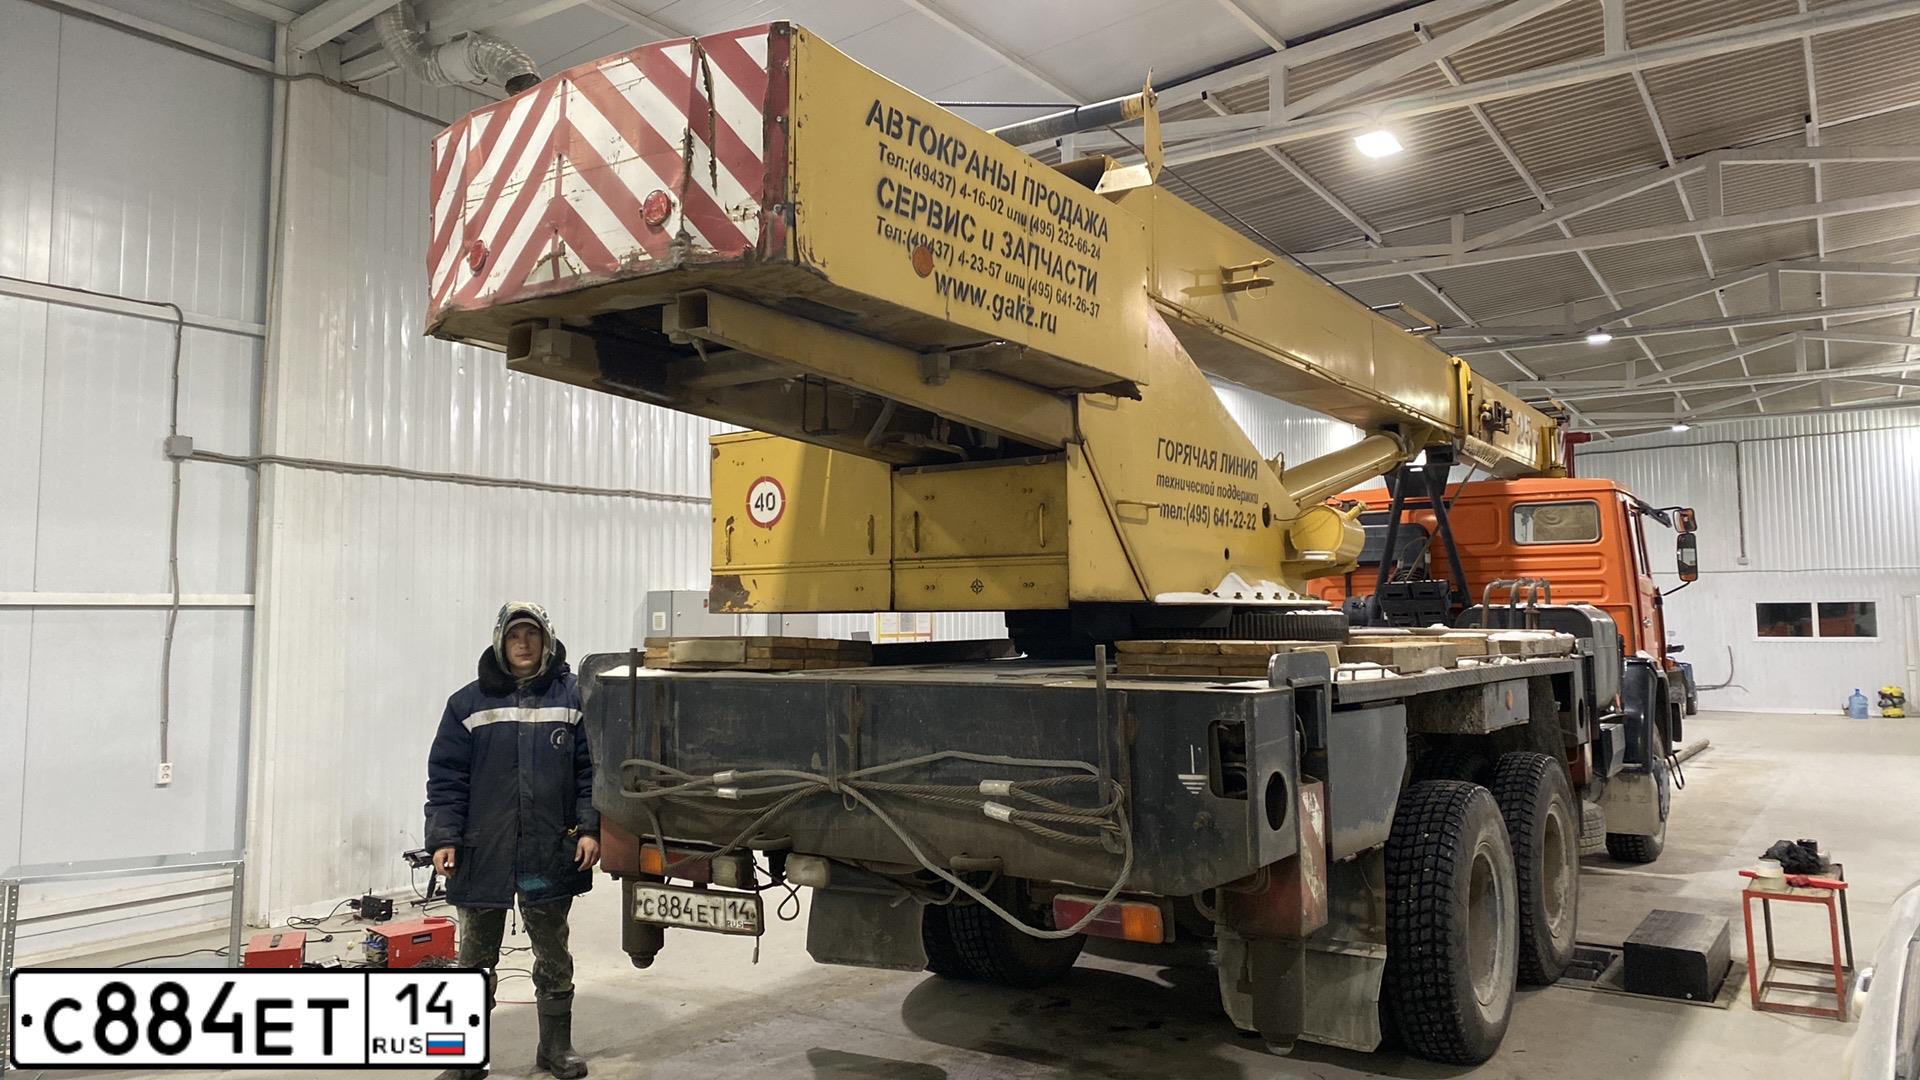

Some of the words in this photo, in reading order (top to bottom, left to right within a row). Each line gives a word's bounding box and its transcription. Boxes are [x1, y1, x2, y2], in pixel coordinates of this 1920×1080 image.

[865, 100, 1016, 195] АВТОКРАНЫ
[1022, 176, 1108, 242] ПРОДАЖА
[878, 142, 956, 198] Тел:(49437)
[960, 183, 1004, 215] 4-16-02
[1006, 208, 1027, 228] или
[1029, 216, 1054, 243] (495)
[1058, 229, 1100, 260] 232-66-24
[876, 177, 976, 243] СЕРВИС
[982, 229, 994, 251] и
[1001, 231, 1097, 295] ЗАПЧАСТИ
[934, 271, 1057, 334] www.gakz.ru
[958, 251, 1002, 279] 4-23-57
[1005, 270, 1025, 290] или
[1027, 277, 1053, 306] (495)
[1056, 289, 1100, 318] 641-26-37
[1157, 438, 1217, 471] ГОРЯЧАЯ
[1220, 453, 1258, 480] ЛИНИЯ
[755, 492, 775, 511] 40
[1156, 474, 1215, 496] технической
[1217, 484, 1258, 504] поддержки
[1160, 503, 1210, 528] тел:(495)
[1214, 508, 1256, 531] 641-22-22
[644, 894, 718, 924] С884ЕТ
[729, 901, 750, 919] 14
